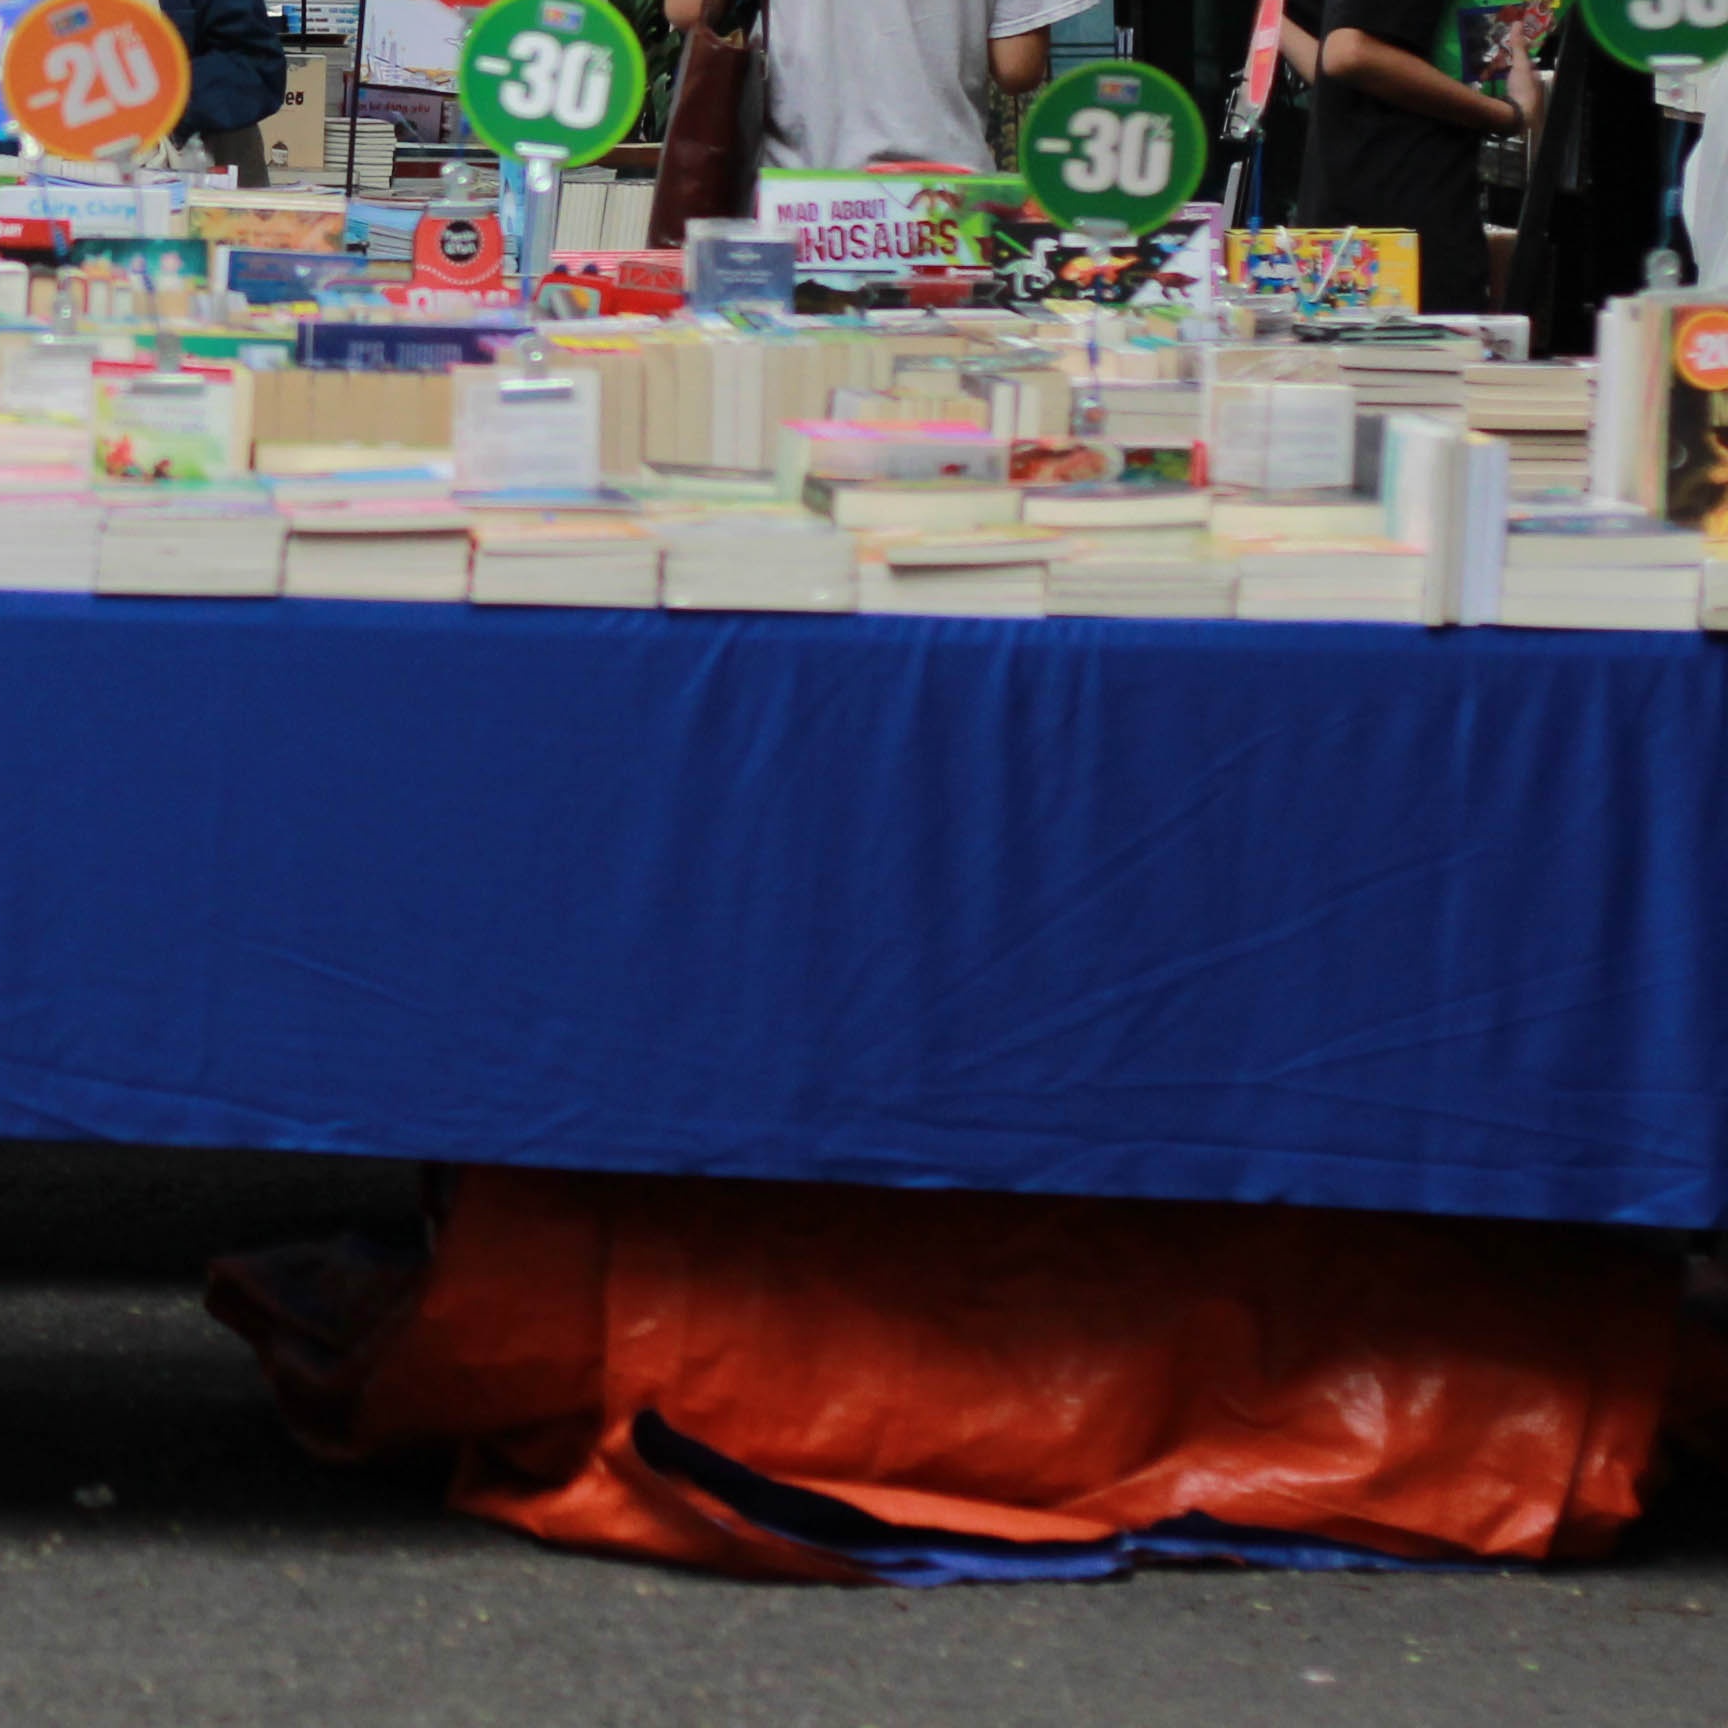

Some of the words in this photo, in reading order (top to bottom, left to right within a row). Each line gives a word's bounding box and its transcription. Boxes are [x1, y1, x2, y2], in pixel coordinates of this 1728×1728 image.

[777, 203, 819, 222] MAD
[831, 198, 888, 221] ABOUT
[794, 219, 960, 263] INOSAURS
